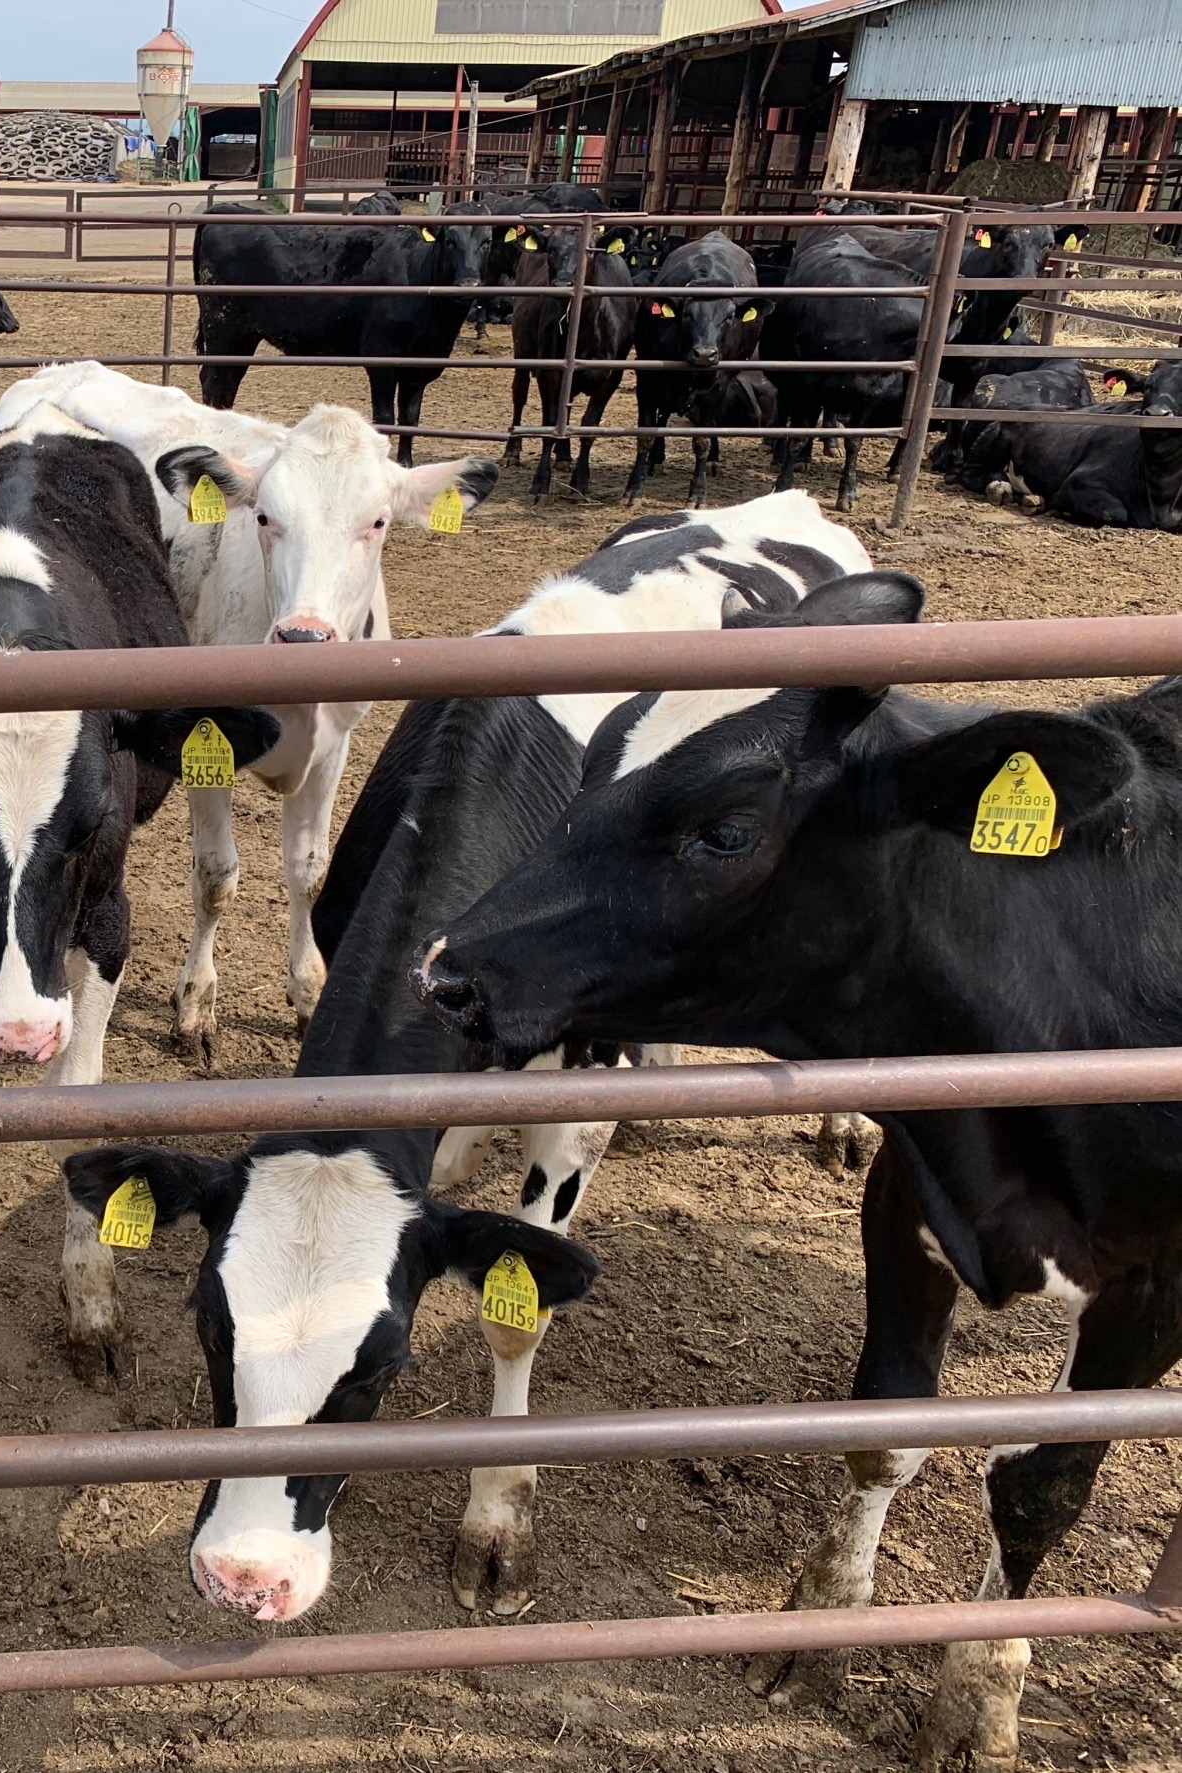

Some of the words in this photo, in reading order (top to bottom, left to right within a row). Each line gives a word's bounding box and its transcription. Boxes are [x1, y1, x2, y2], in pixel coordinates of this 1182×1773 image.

[185, 746, 197, 755] JP
[982, 794, 1001, 805] JP
[1007, 795, 1050, 807] 13908
[486, 1274, 500, 1283] JP
[505, 1279, 535, 1295] 13641
